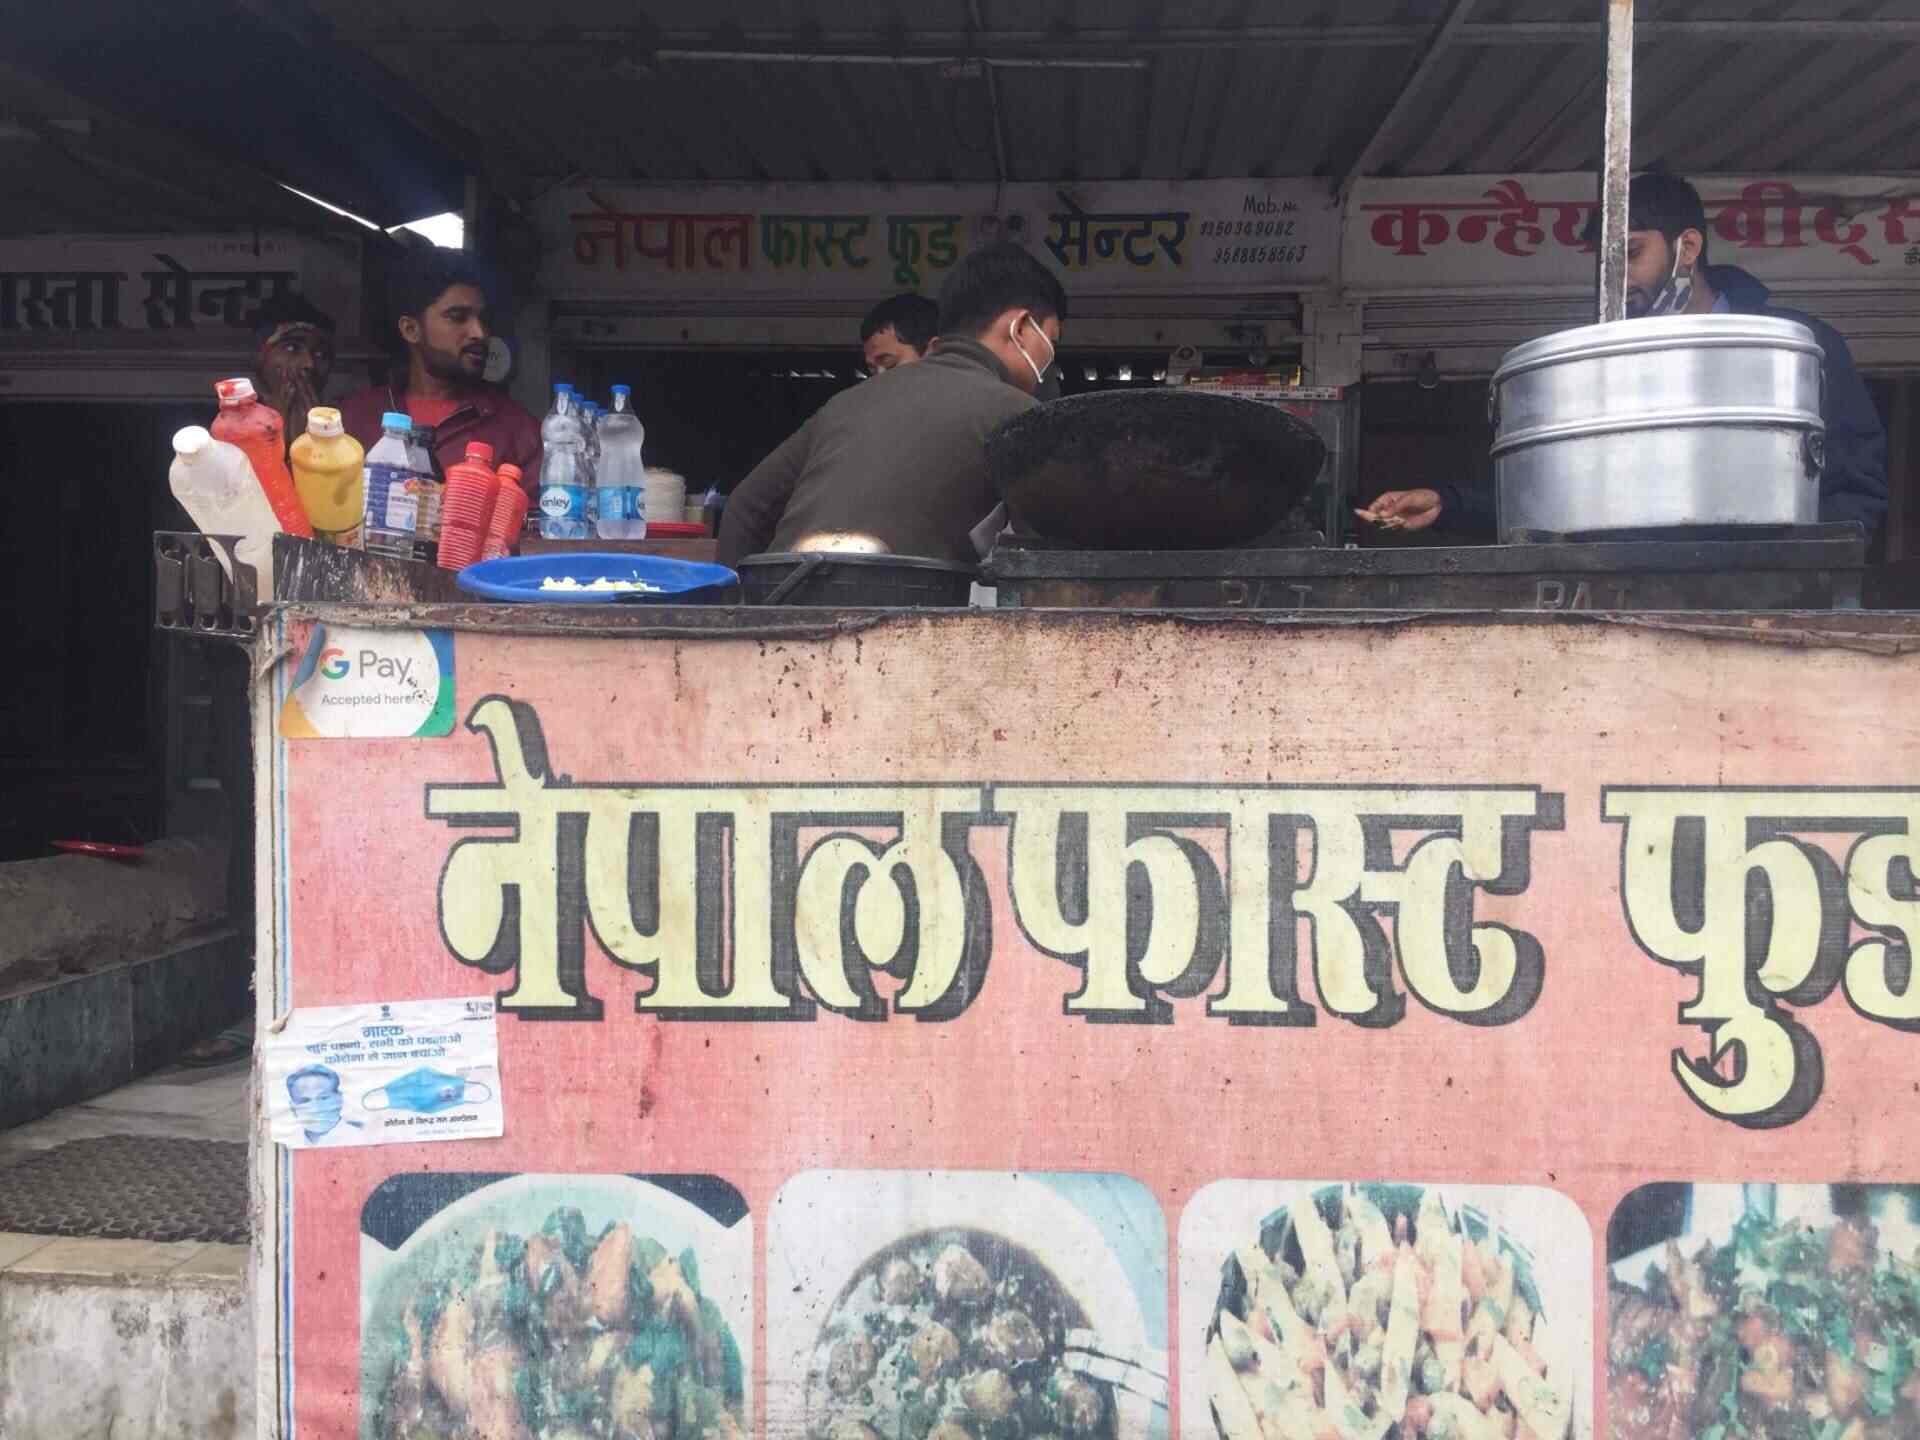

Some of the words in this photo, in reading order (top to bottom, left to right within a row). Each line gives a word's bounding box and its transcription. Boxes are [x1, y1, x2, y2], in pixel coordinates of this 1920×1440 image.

[569, 192, 754, 271] नेपाल
[760, 214, 869, 271] फास्ट
[886, 214, 961, 285] फूड
[1043, 191, 1190, 267] सेन्टर
[1360, 179, 1600, 257] कन्हैय
[0, 271, 129, 332] ास्ता
[319, 648, 351, 680] G
[359, 649, 413, 685] Pay
[321, 694, 381, 707] Accepted
[384, 693, 414, 706] here
[425, 693, 994, 1022] नेपाल
[990, 783, 1566, 1027] फास्ट
[361, 1024, 404, 1038] मास्क
